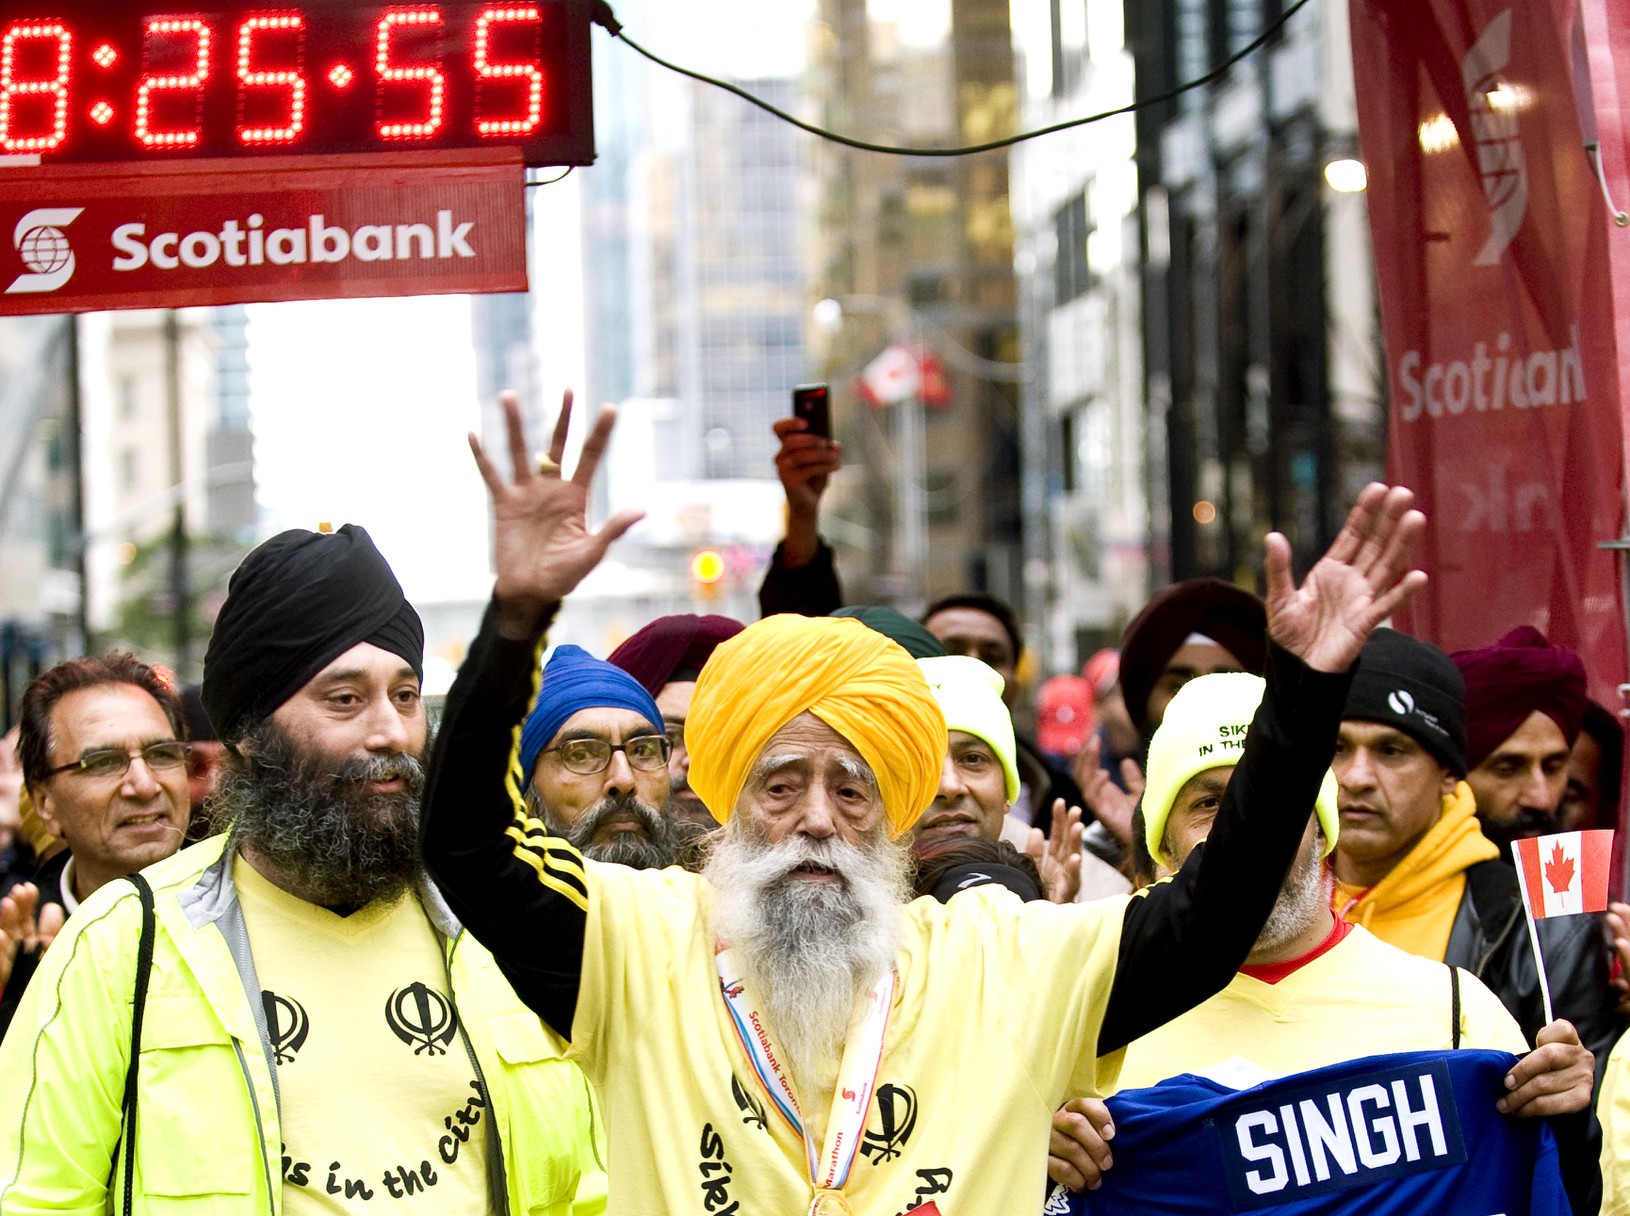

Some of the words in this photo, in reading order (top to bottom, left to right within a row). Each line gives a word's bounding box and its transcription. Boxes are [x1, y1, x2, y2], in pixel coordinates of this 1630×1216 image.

[111, 210, 476, 272] Scotiabank
[1199, 743, 1213, 757] IN
[1219, 724, 1248, 737] SIK
[749, 1010, 781, 1073] Scotiabank
[823, 1131, 844, 1188] Marathon
[1234, 1073, 1448, 1196] SINGH
[326, 1160, 373, 1200] in
[383, 1160, 438, 1199] the
